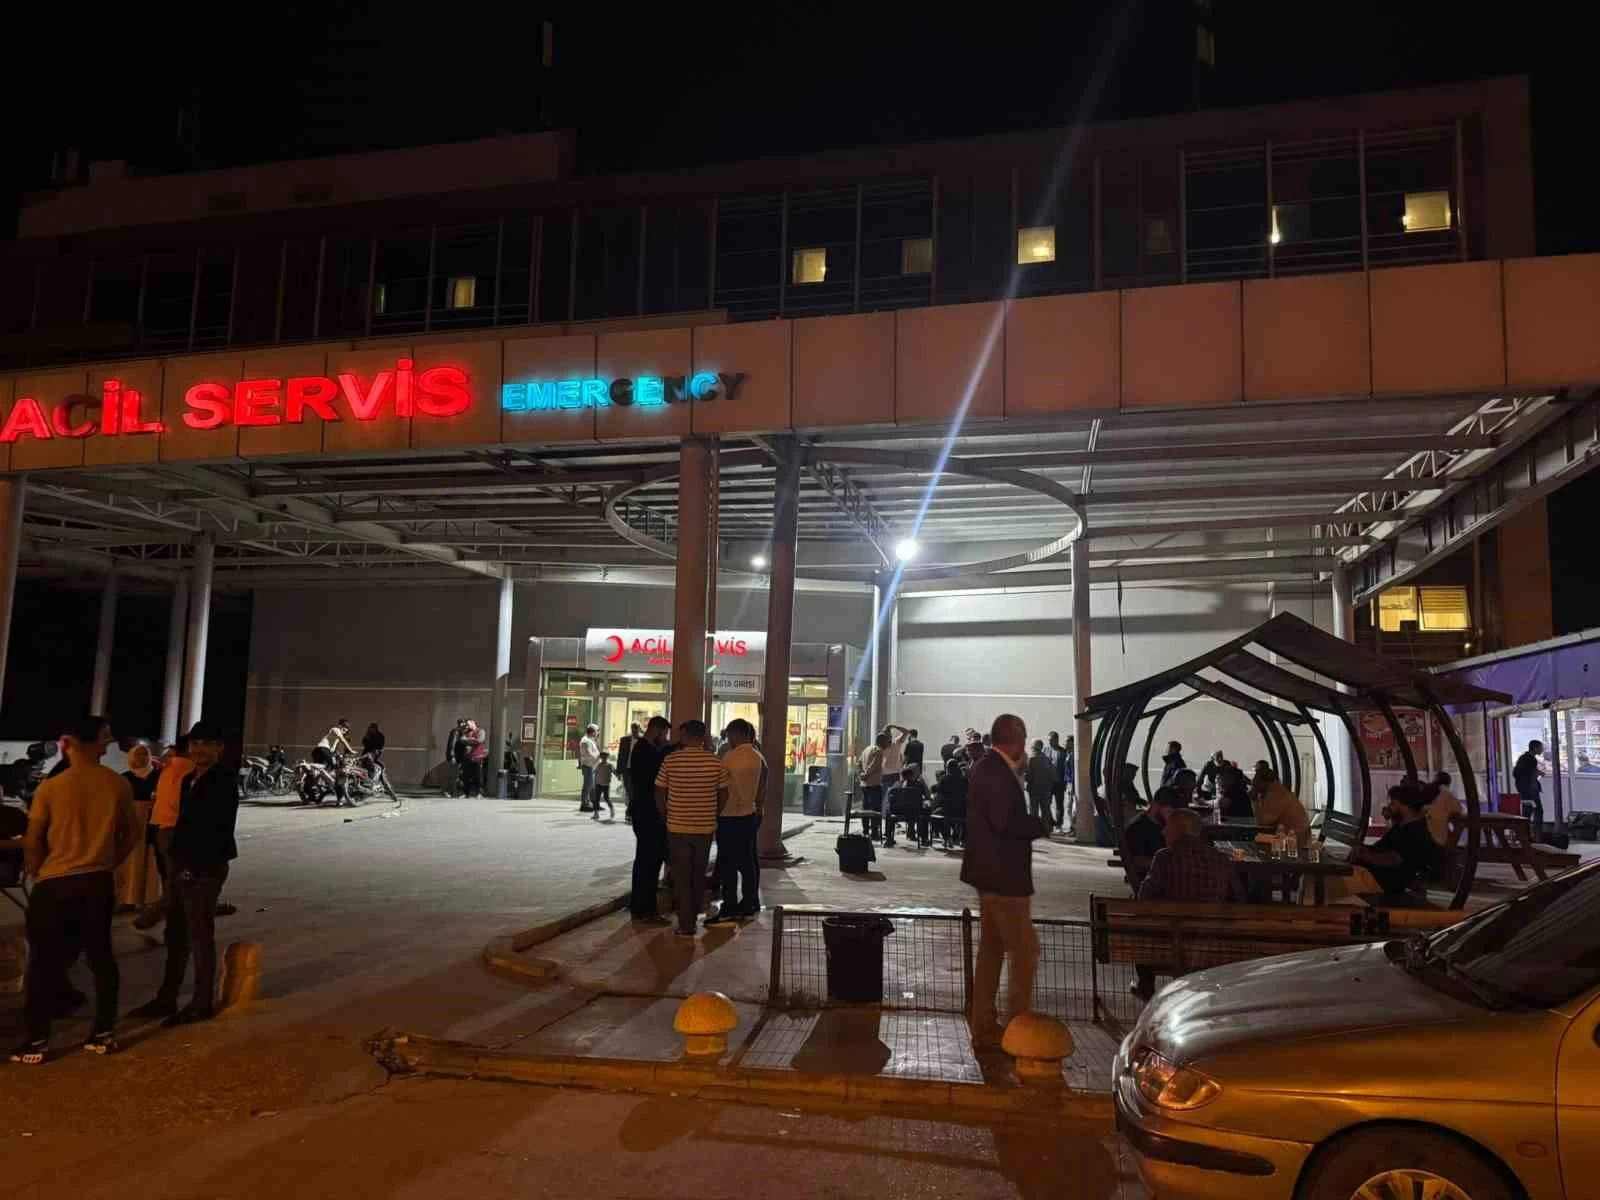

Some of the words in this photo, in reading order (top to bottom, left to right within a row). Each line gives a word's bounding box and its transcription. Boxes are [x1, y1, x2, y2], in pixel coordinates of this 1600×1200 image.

[0, 380, 164, 443] ACİL
[182, 358, 472, 429] SERVİS
[502, 372, 746, 410] EMERGENCY
[631, 635, 673, 655] ACİL
[716, 636, 749, 656] VİS
[713, 679, 732, 689] ASTA
